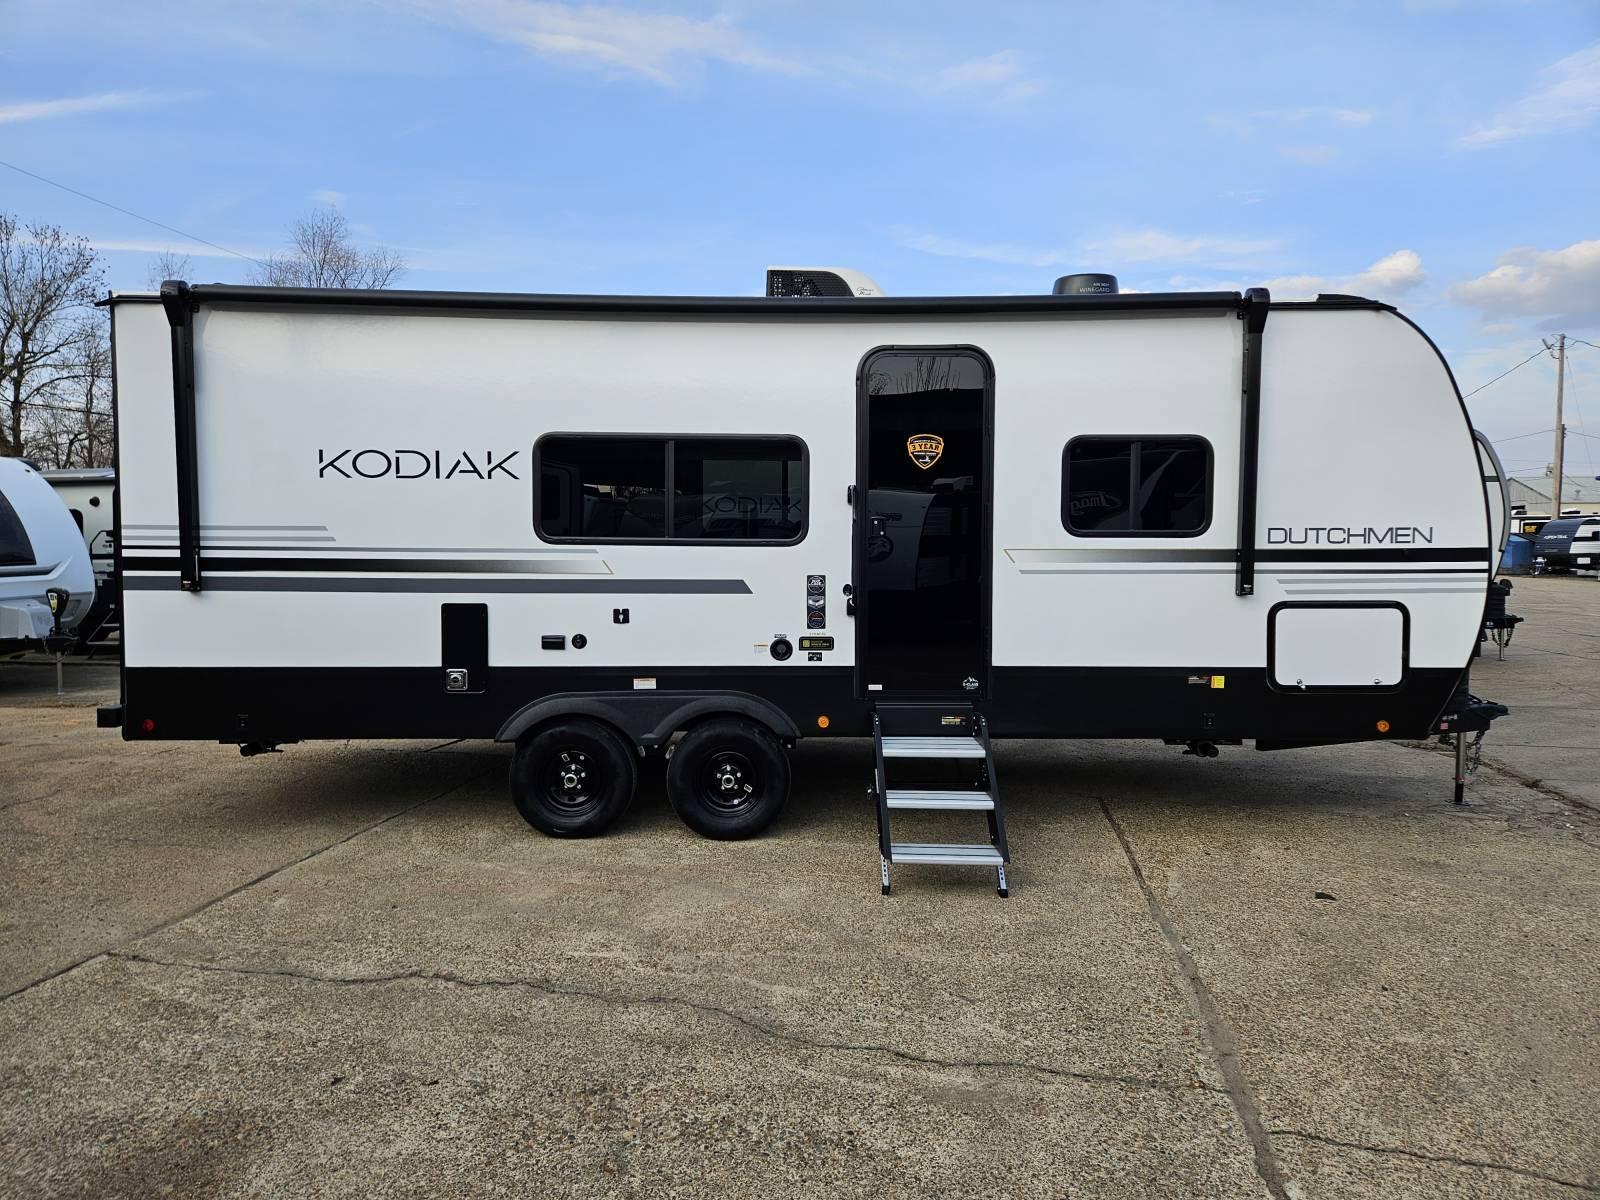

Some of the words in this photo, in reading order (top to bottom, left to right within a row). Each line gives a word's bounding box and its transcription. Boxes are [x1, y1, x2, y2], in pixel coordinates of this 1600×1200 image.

[918, 443, 940, 451] YEAR
[318, 448, 520, 480] KODIAK
[1267, 526, 1433, 544] DUTCHMEN
